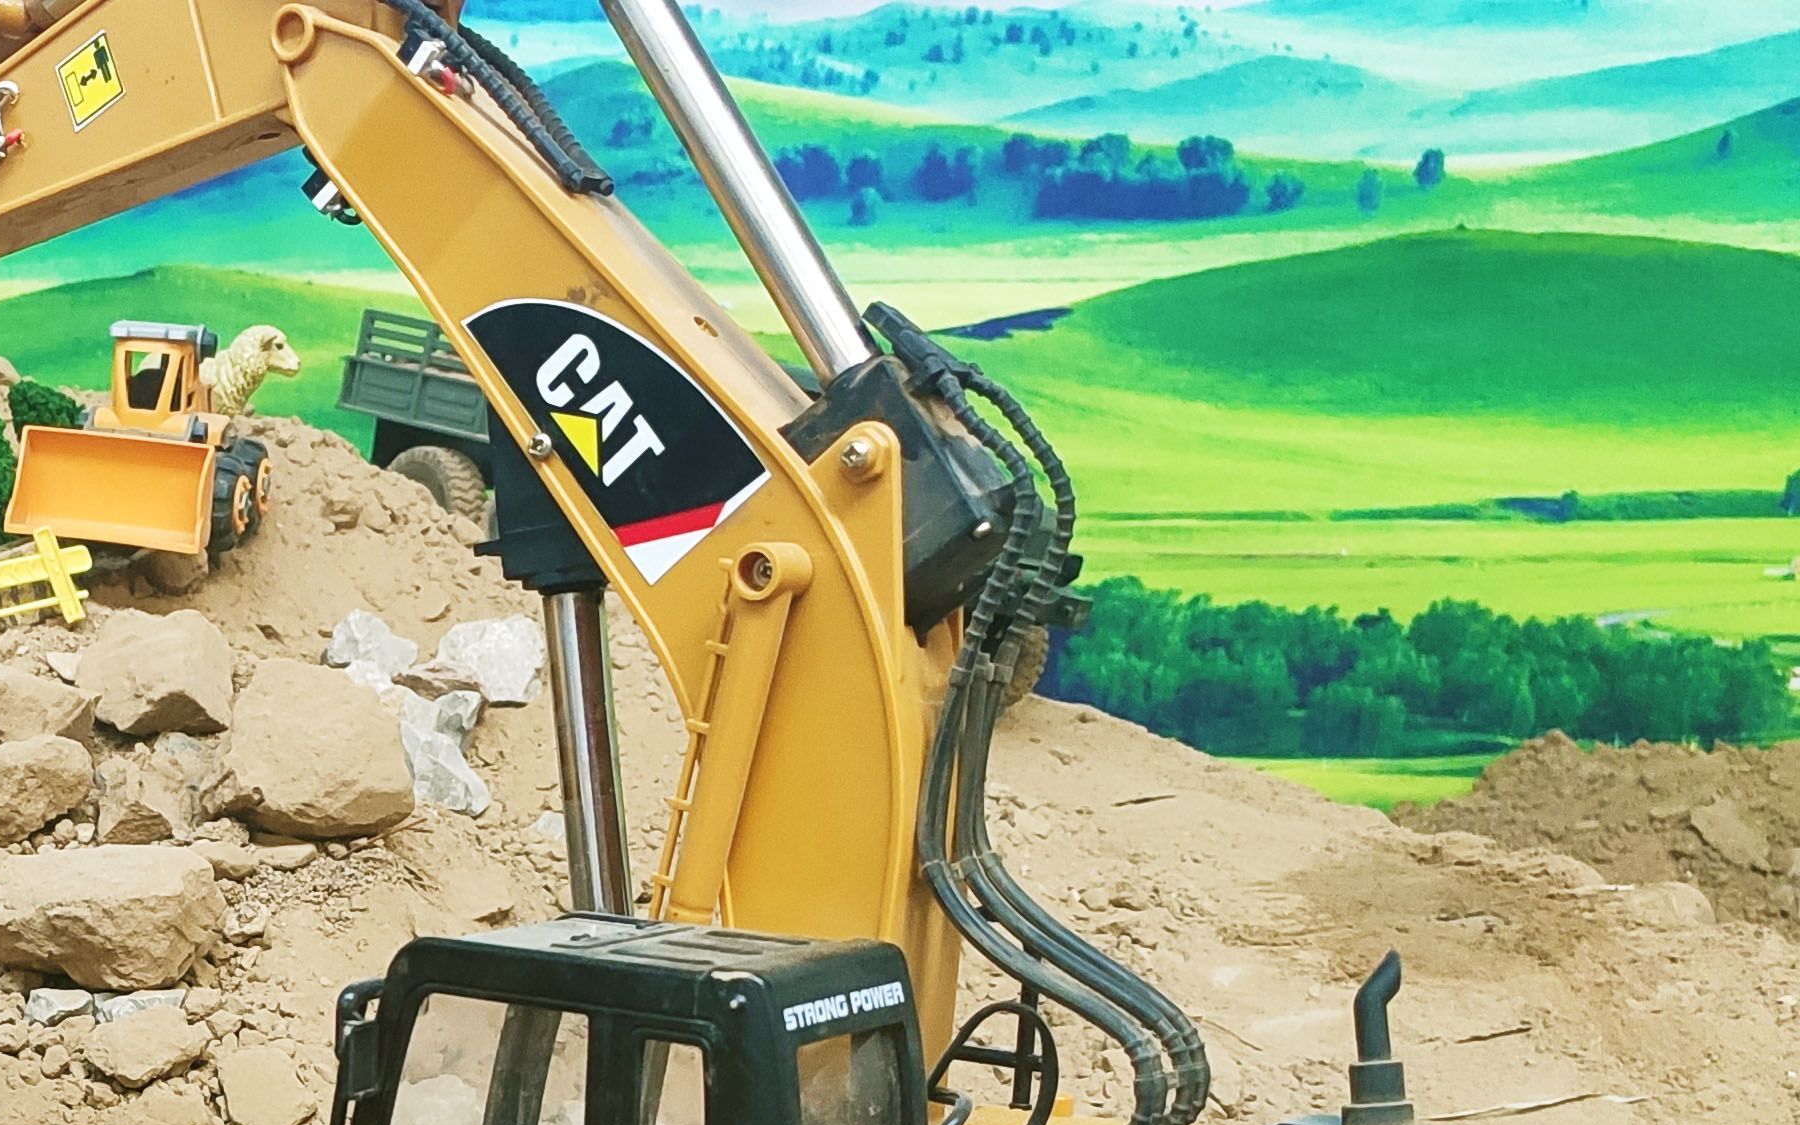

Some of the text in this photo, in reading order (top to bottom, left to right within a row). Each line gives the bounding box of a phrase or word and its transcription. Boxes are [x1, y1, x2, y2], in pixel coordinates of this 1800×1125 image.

[536, 334, 666, 487] CAT
[783, 981, 905, 1032] STRONG POWER
